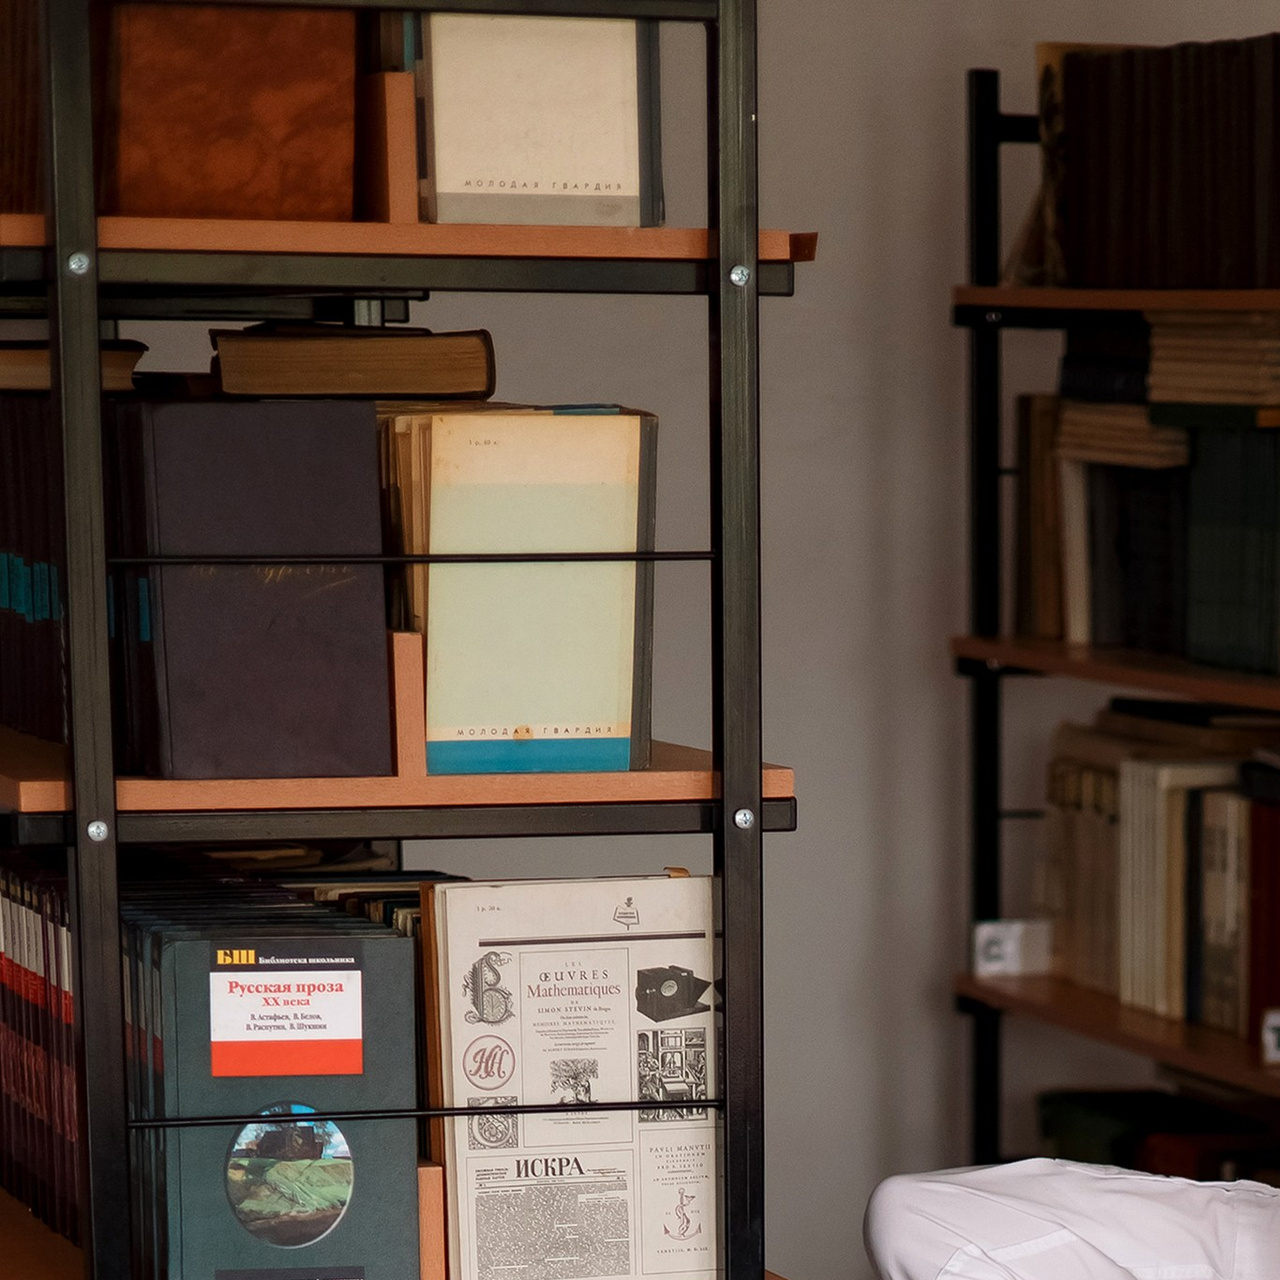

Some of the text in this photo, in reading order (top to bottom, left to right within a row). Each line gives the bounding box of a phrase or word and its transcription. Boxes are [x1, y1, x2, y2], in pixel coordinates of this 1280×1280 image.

[464, 180, 622, 191] МОЛОДАЯ ГВАРДИЯ
[457, 726, 613, 736] МОЛОДАЯ ГВАРДИЯ
[217, 950, 255, 965] БШ
[258, 956, 308, 964] Библиотека
[227, 980, 344, 997] Русская проза
[527, 982, 621, 999] Mathematiques
[283, 998, 310, 1006] века
[515, 1157, 585, 1178] ИСКРА
